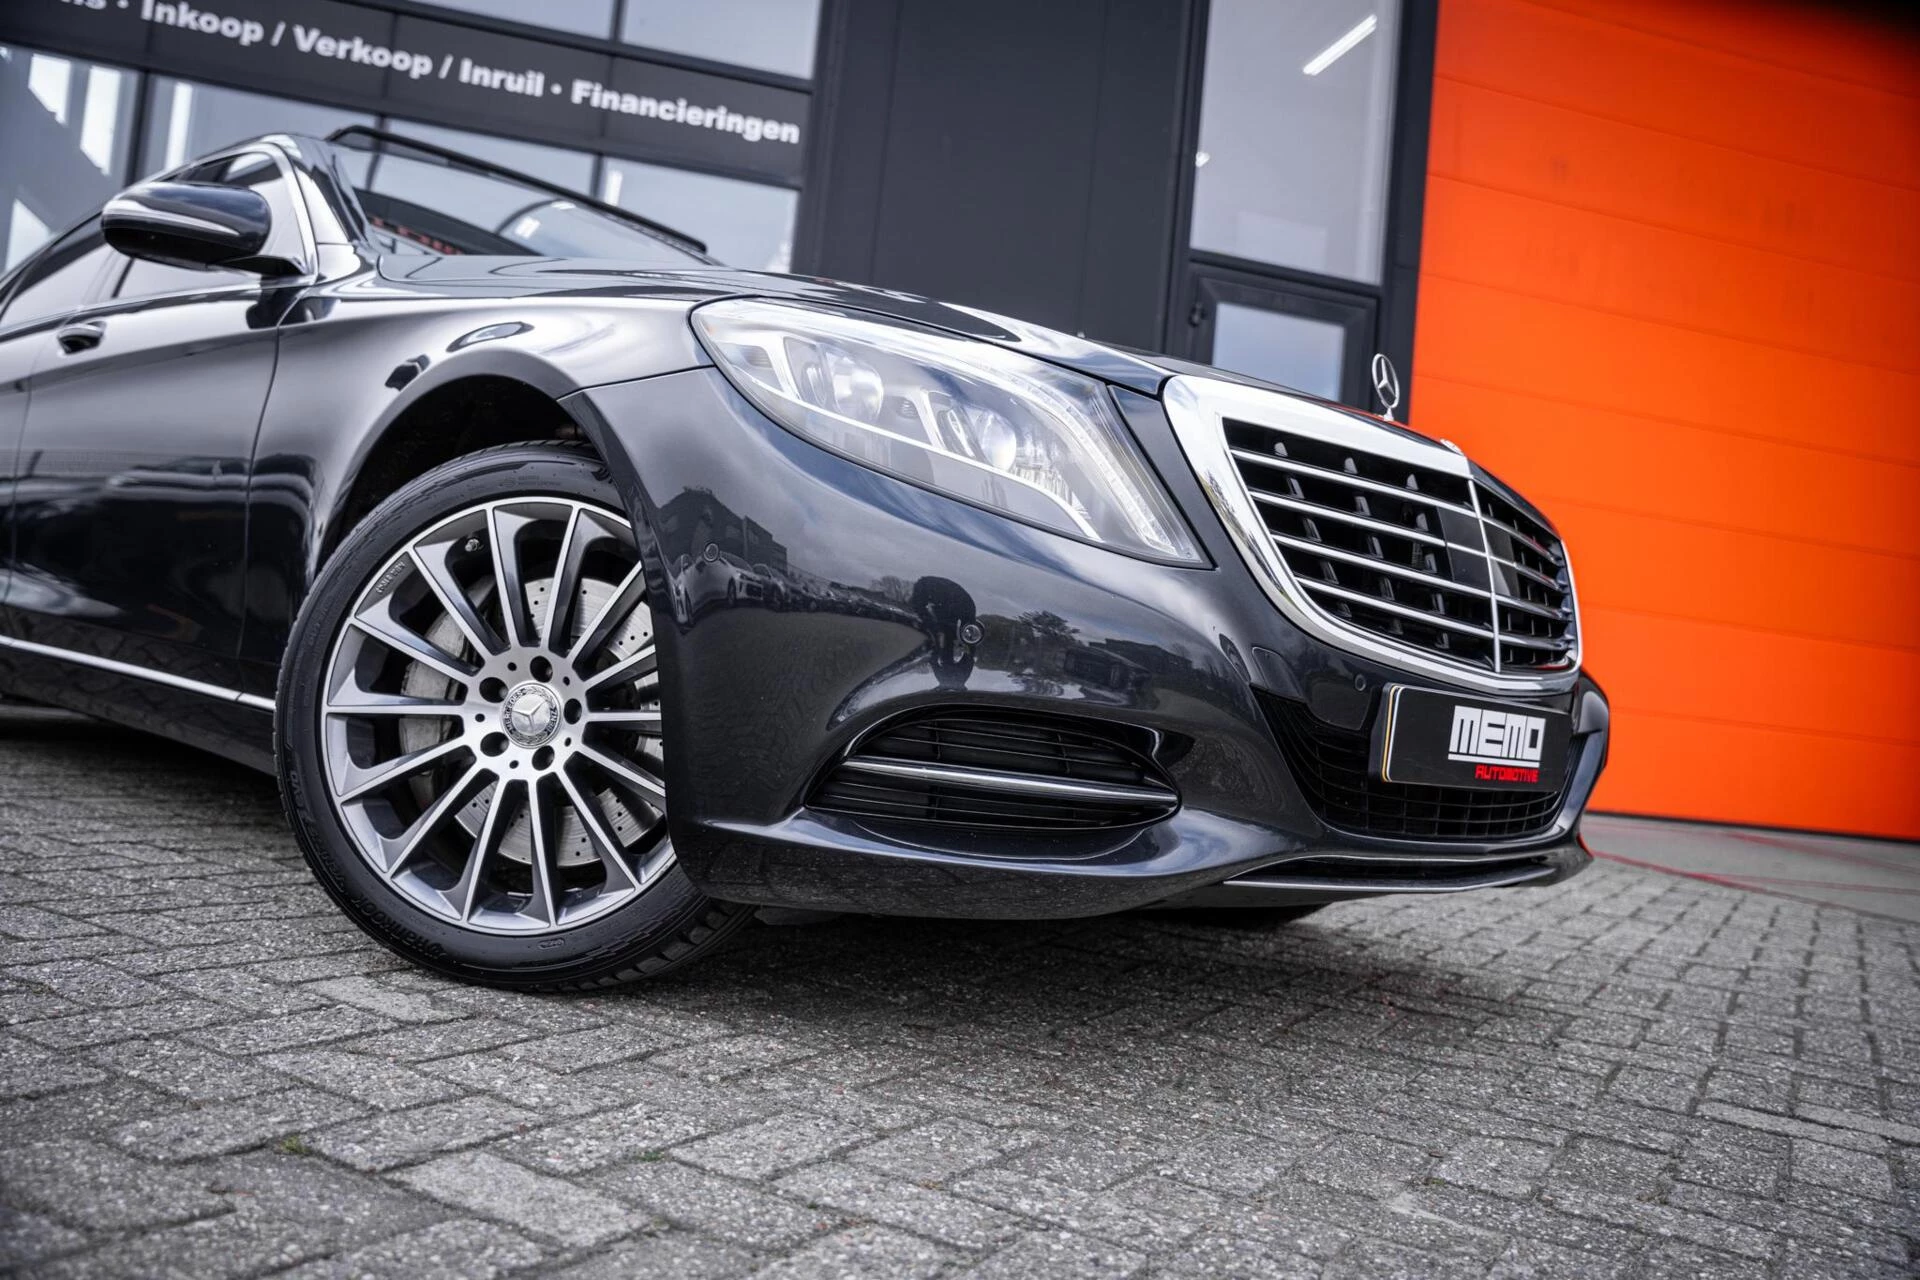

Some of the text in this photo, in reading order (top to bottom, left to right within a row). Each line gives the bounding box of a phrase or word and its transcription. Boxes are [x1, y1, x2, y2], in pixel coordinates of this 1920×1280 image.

[140, 0, 264, 46] Inkoop
[292, 24, 434, 79] Verkoop
[458, 57, 546, 97] Inruil
[571, 78, 801, 144] Financieringen
[1449, 705, 1546, 761] MEMO
